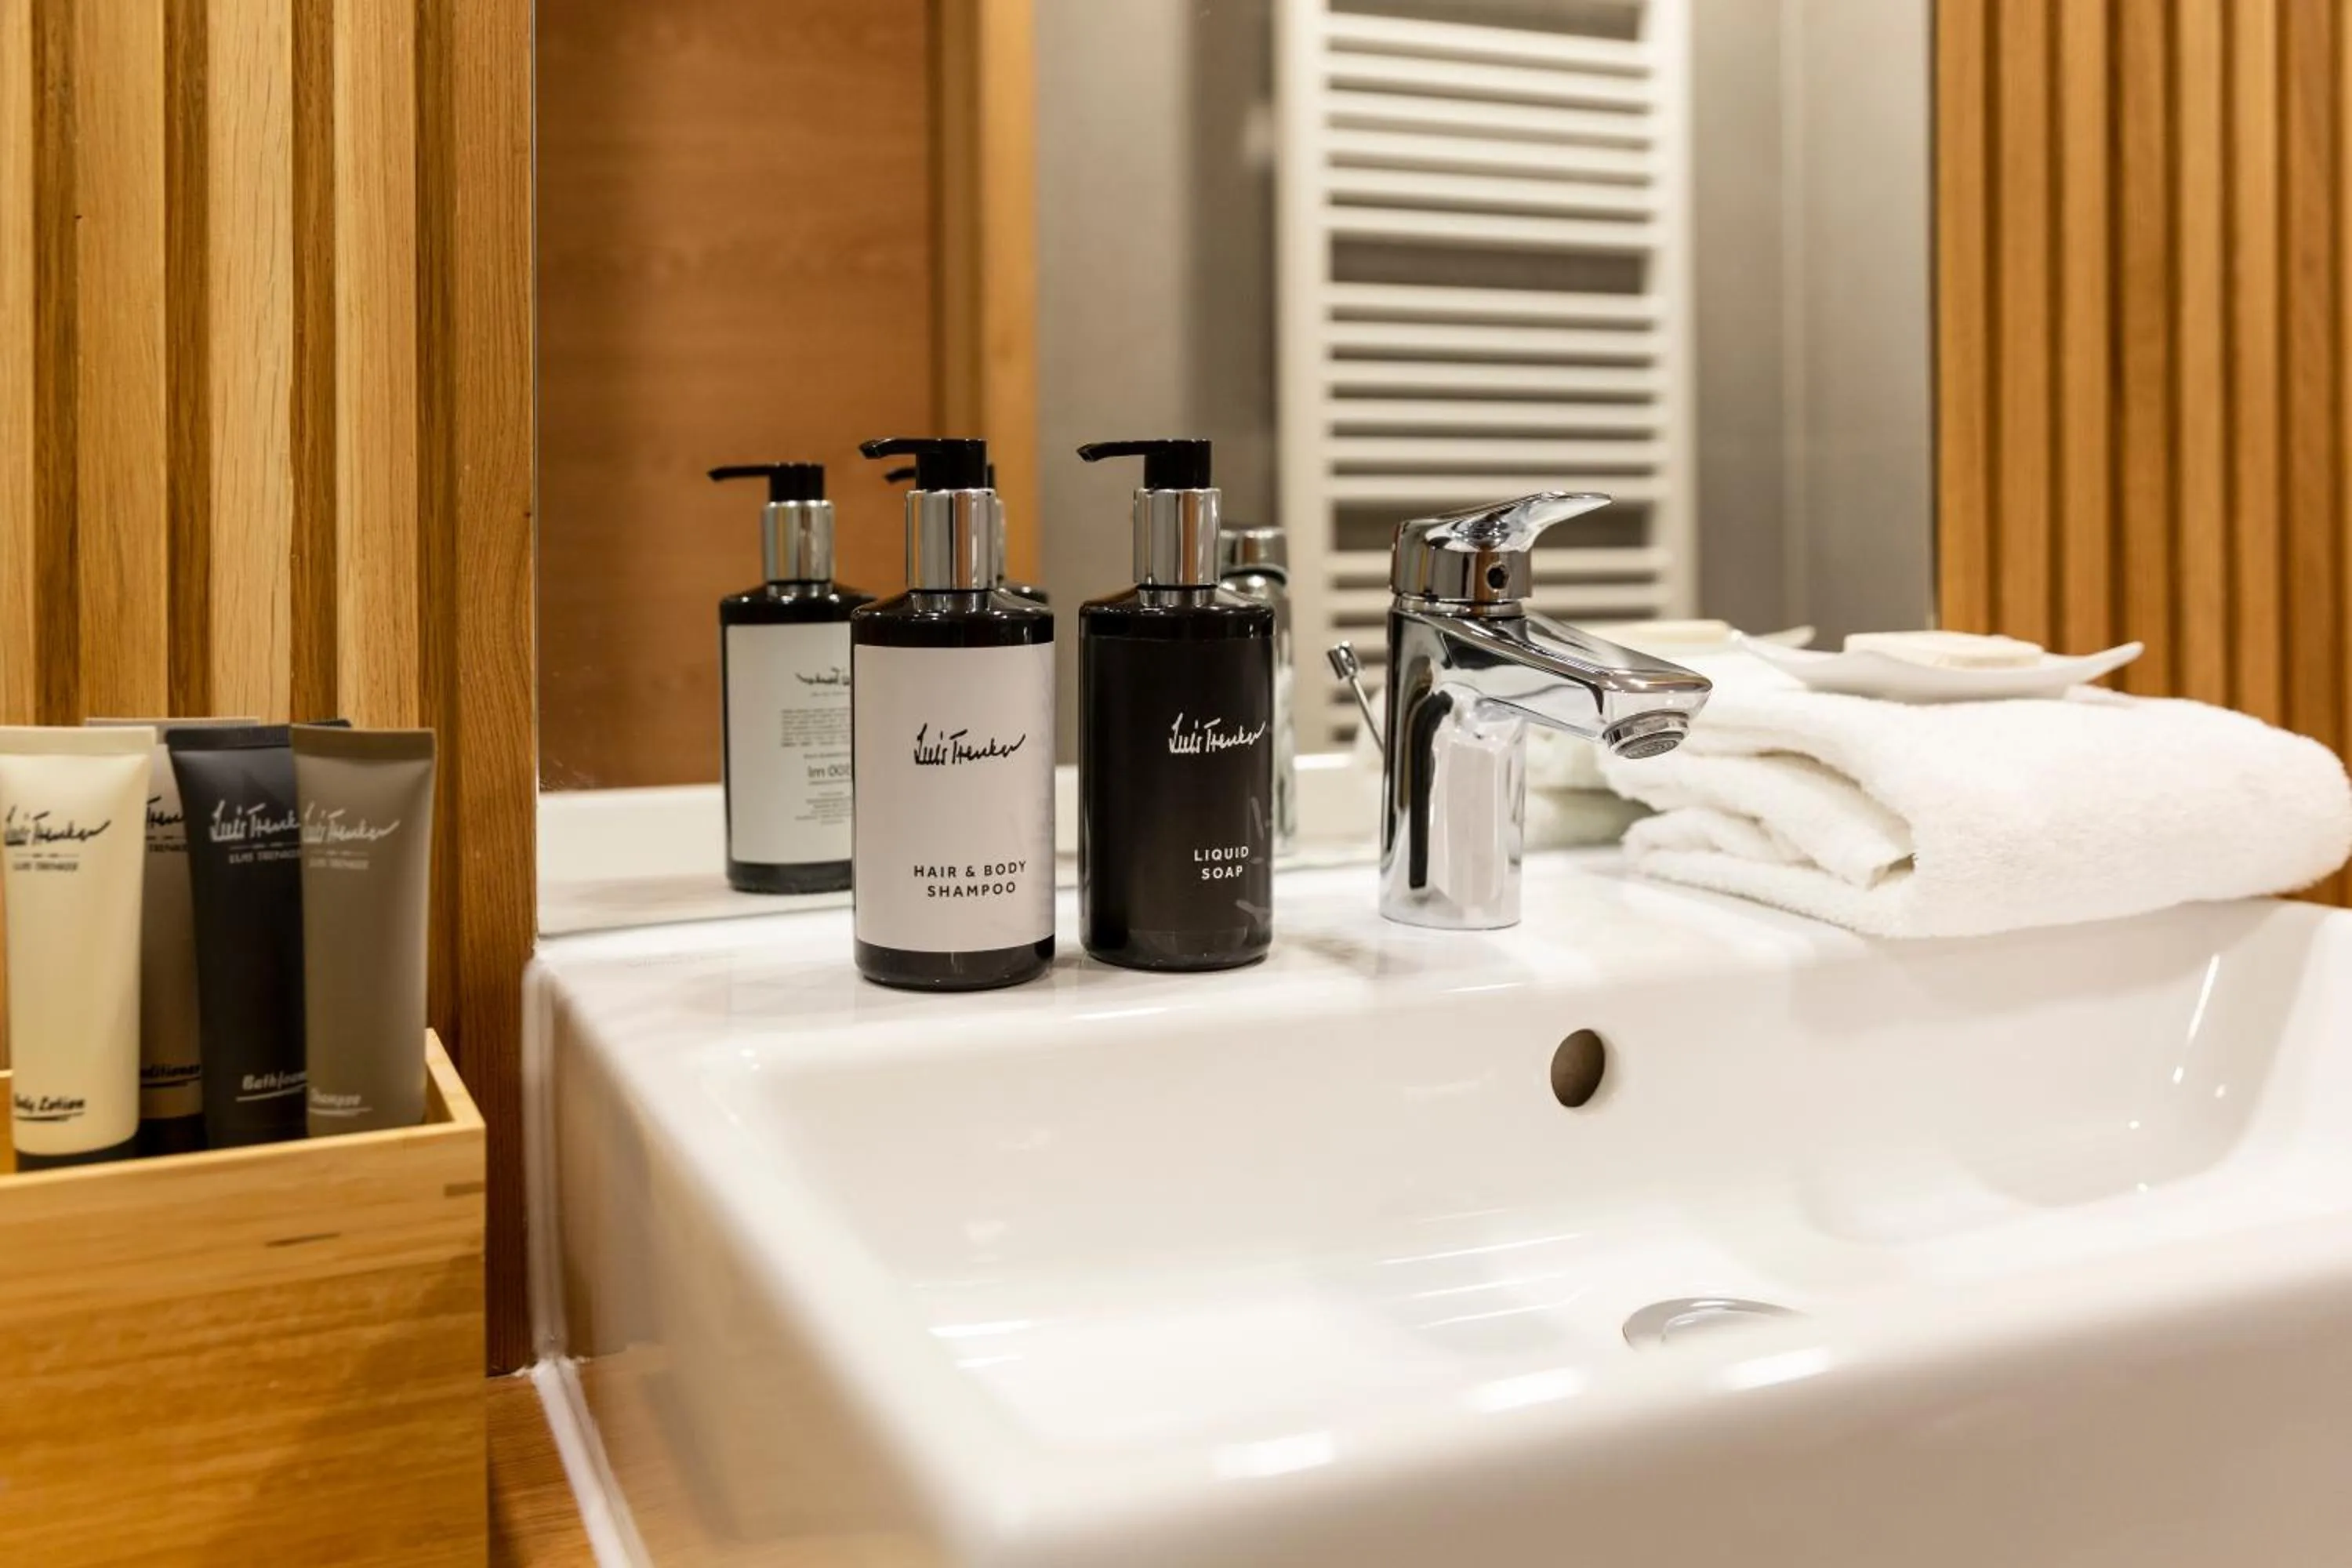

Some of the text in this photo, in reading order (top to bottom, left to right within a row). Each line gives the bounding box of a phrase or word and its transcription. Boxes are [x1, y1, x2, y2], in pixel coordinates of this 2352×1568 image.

[247, 802, 301, 839] Trenk
[1194, 846, 1249, 862] LIQUID
[913, 861, 1026, 878] HAIR & BODY
[1201, 865, 1243, 880] SOAP
[927, 881, 1016, 898] SHAMPOO
